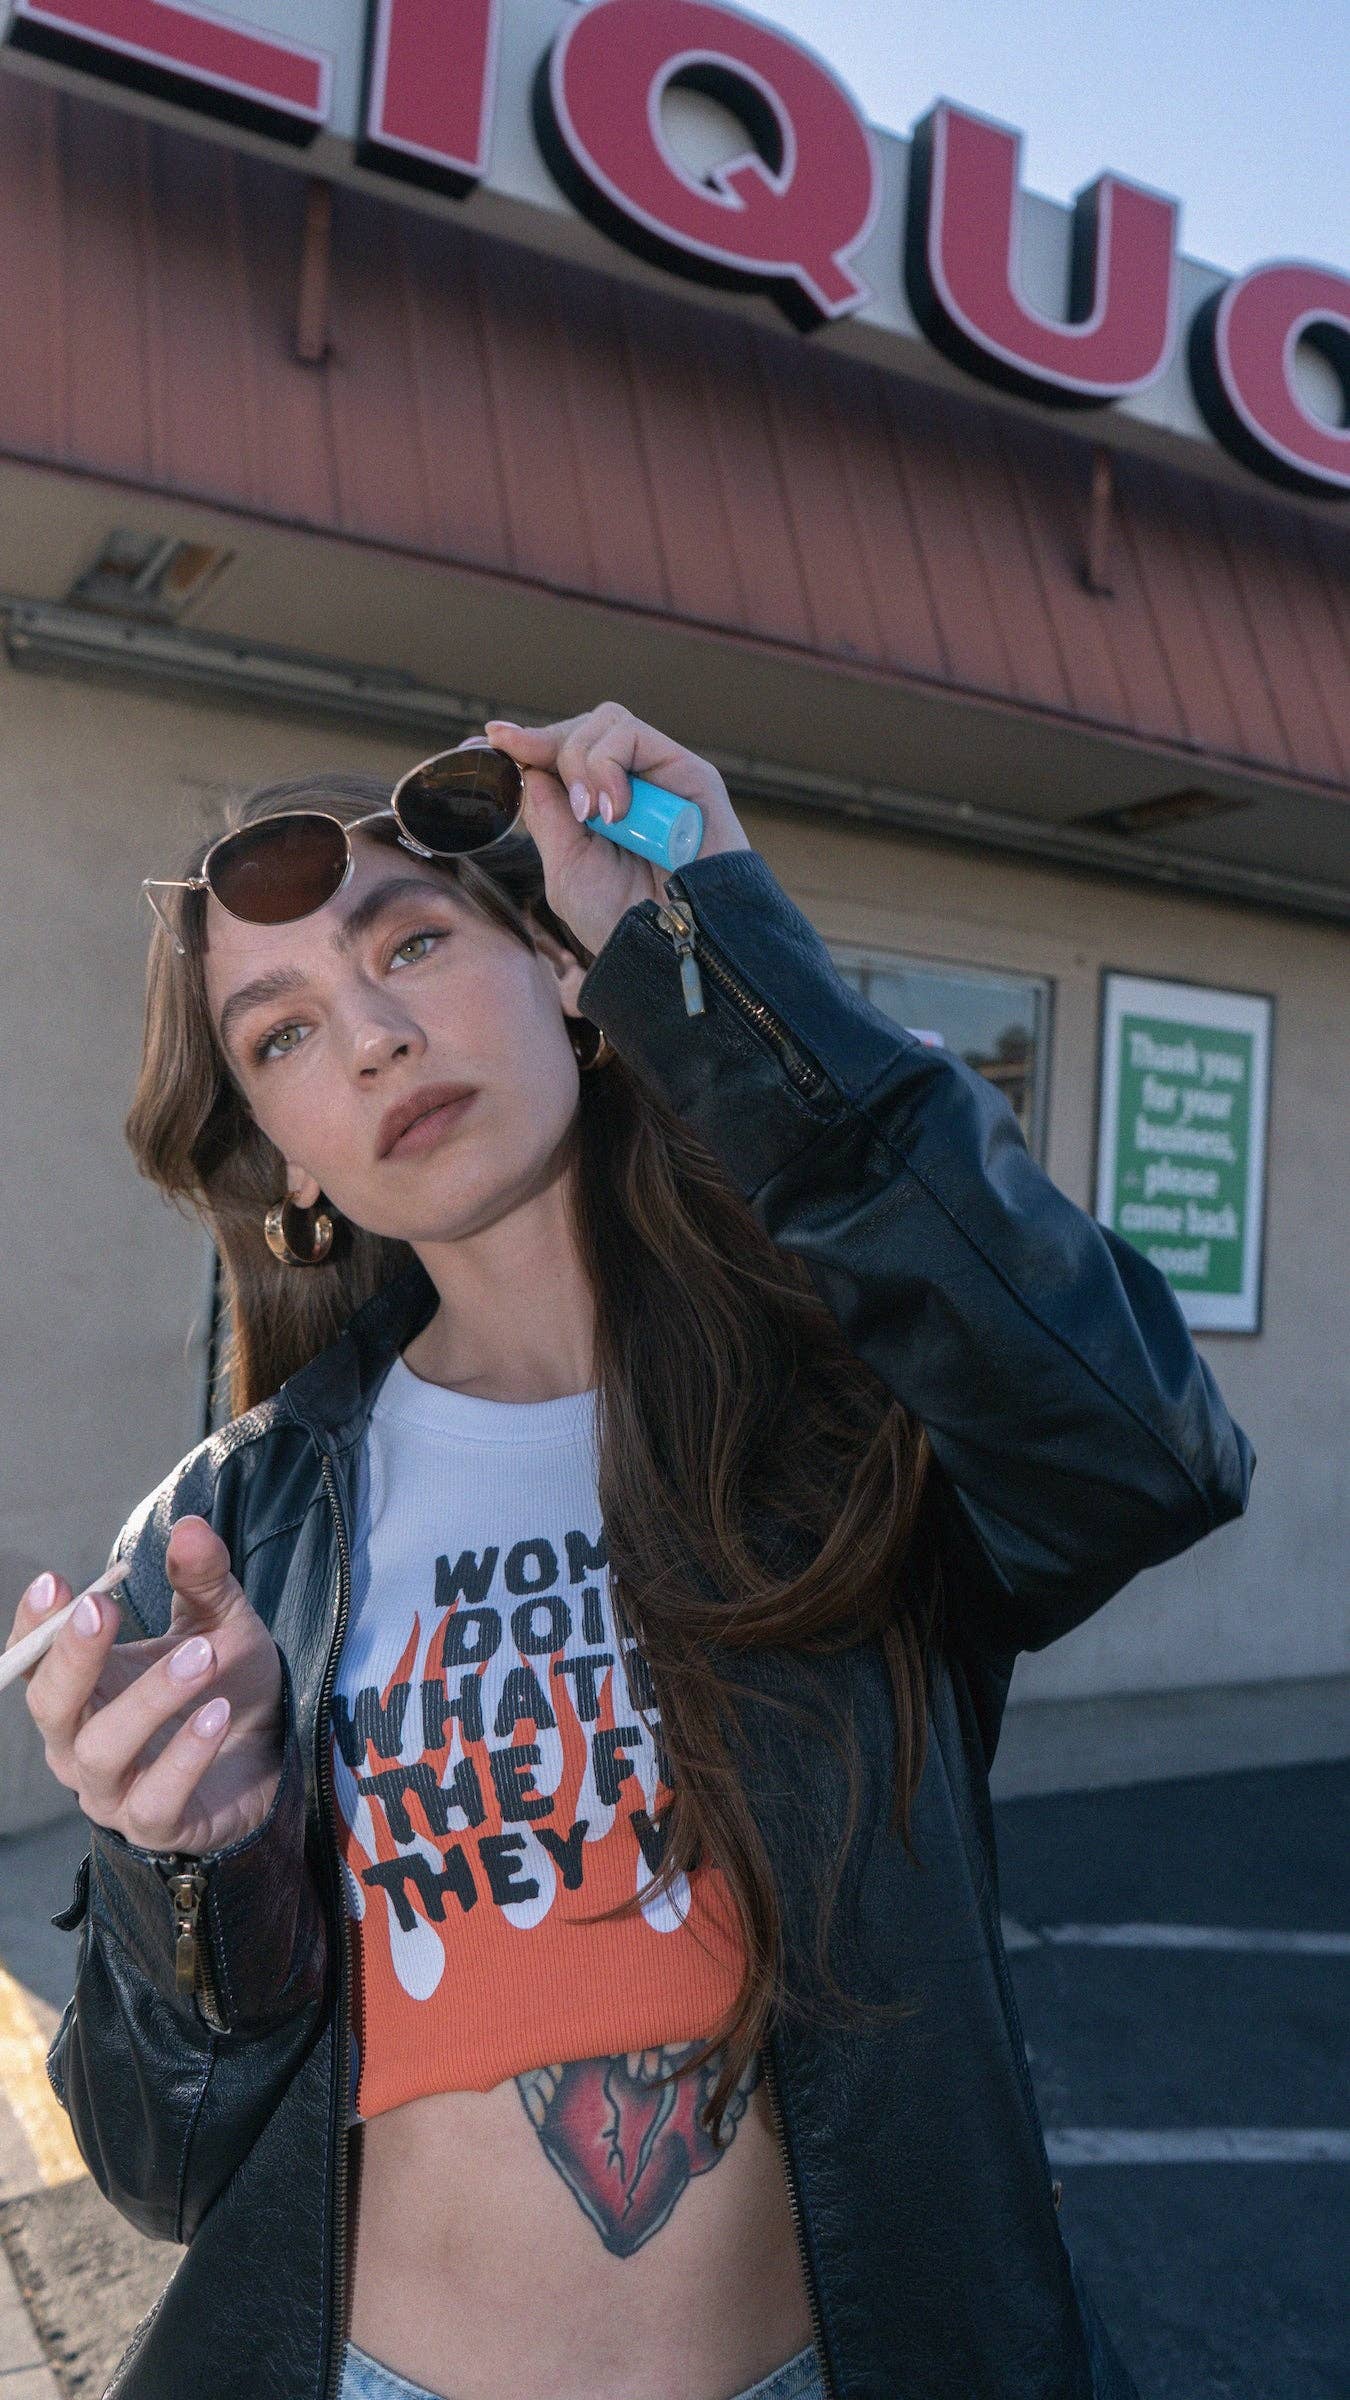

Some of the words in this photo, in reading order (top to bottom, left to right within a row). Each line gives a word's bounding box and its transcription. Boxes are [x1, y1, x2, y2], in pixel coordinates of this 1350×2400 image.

[1130, 1032, 1199, 1076] Thank
[1201, 1052, 1245, 1087] you
[1142, 1074, 1177, 1112] for
[1181, 1089, 1233, 1122] your
[1120, 1203, 1183, 1234] come
[1185, 1201, 1237, 1240] back
[441, 1586, 635, 1668] DOI
[357, 1743, 555, 1845] THE
[361, 1819, 591, 1932] THEY
